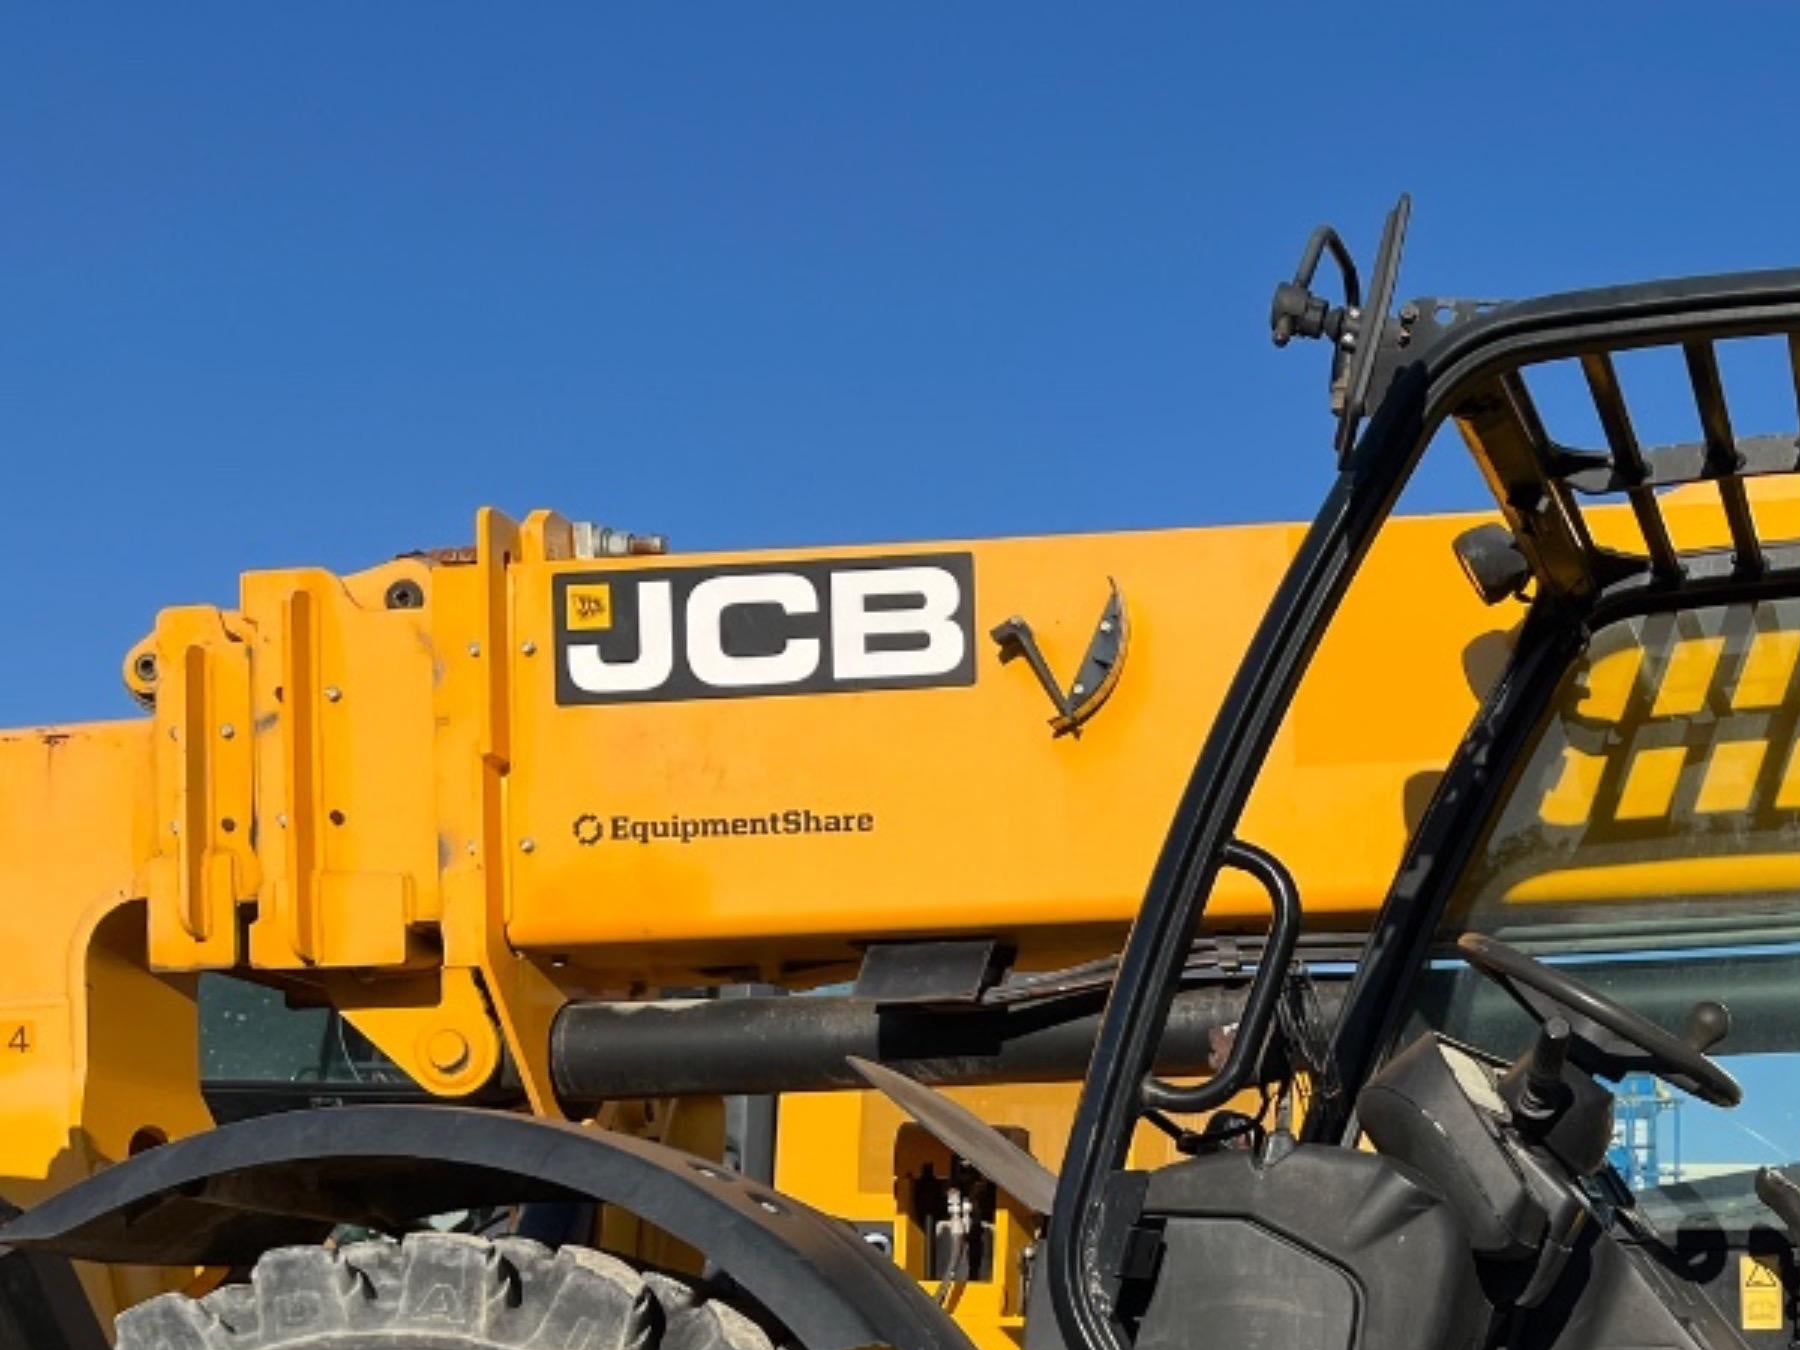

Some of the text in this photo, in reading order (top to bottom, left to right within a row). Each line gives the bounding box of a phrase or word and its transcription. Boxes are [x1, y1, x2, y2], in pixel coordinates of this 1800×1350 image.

[567, 566, 965, 692] JCB
[609, 808, 875, 845] EquipmentShare
[8, 1024, 31, 1054] 4
